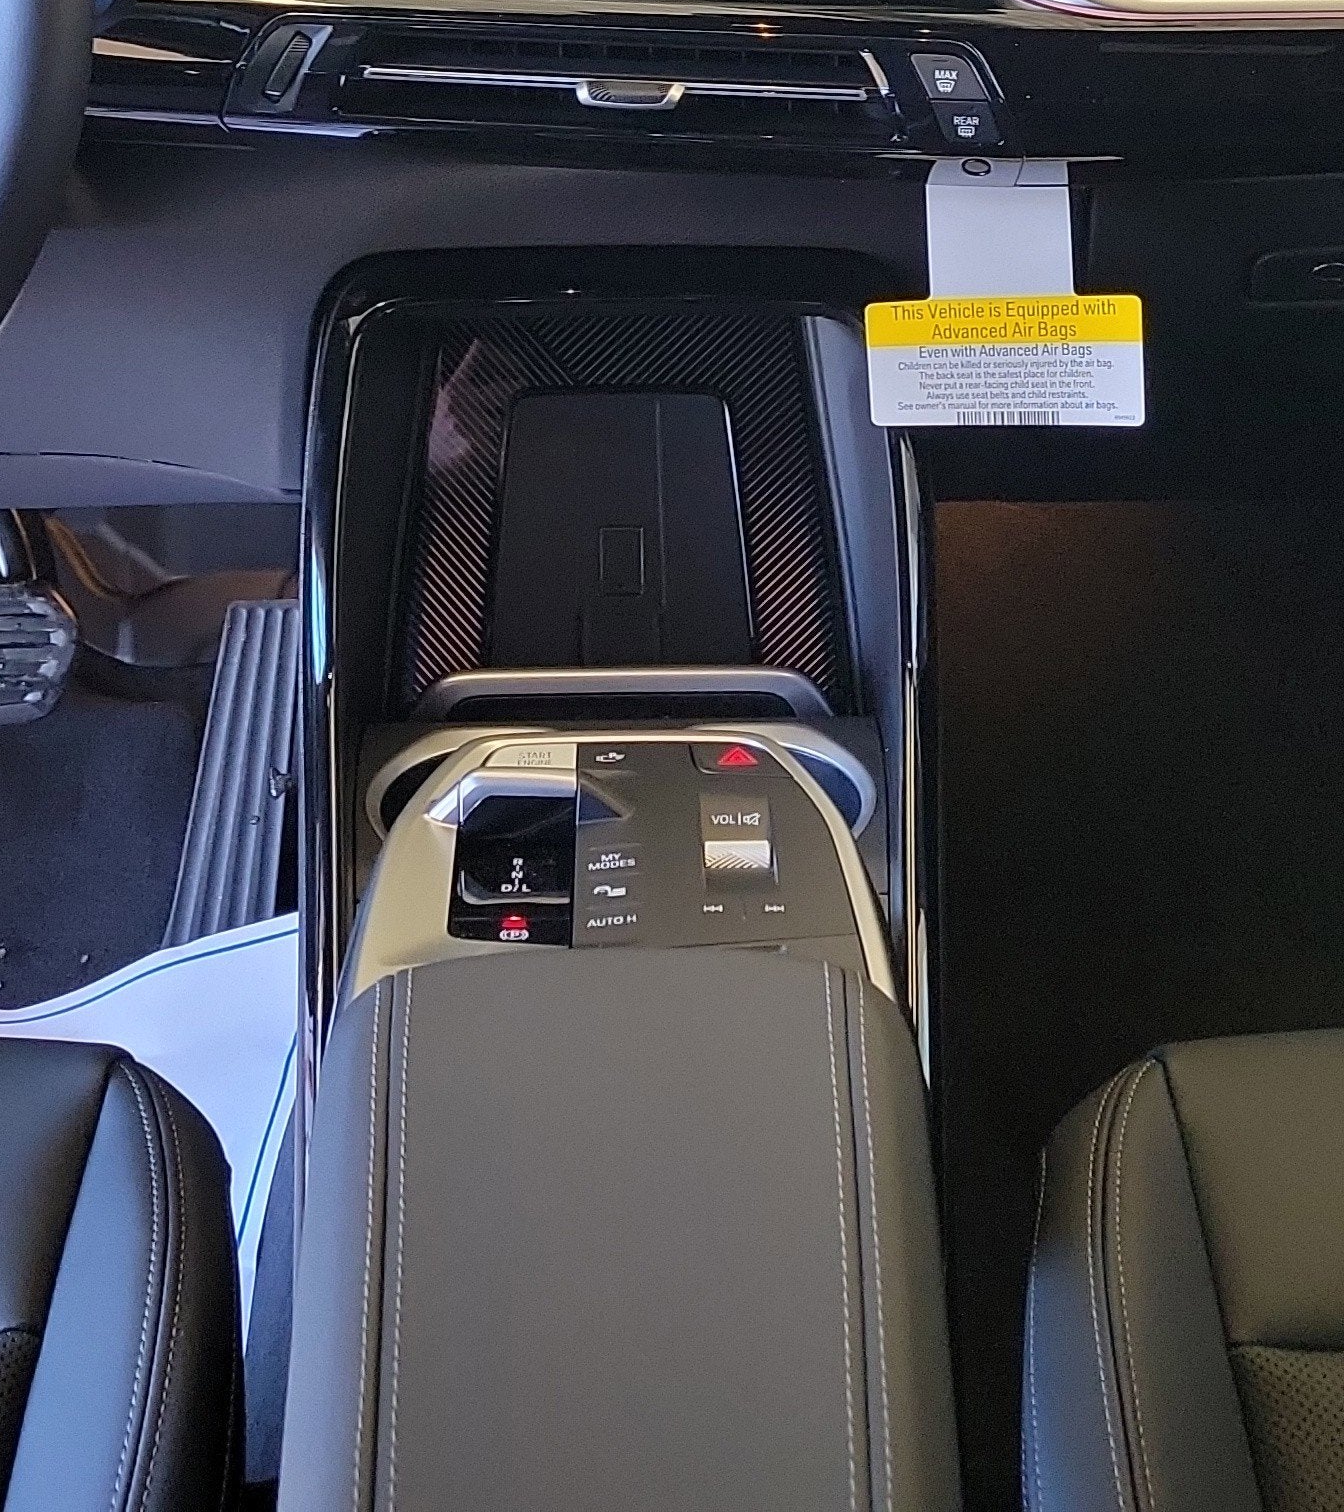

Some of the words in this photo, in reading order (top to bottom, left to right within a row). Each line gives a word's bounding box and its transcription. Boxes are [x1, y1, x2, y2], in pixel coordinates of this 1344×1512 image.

[934, 69, 958, 80] MAX
[953, 116, 979, 126] REAR
[890, 304, 924, 321] This
[928, 302, 985, 319] Vehicle
[988, 302, 1001, 318] is
[1006, 300, 1079, 320] Equipped
[1083, 299, 1116, 315] with
[932, 322, 1007, 340] Advanced
[1012, 322, 1034, 338] Air
[1038, 321, 1077, 340] Bags
[919, 346, 948, 359] Even
[950, 345, 976, 358] with
[979, 344, 1039, 357] Advanced
[1041, 343, 1058, 356] Air
[1061, 343, 1093, 359] Bags
[898, 361, 932, 370] Children
[933, 362, 947, 370] can
[948, 360, 959, 369] be
[960, 360, 982, 369] killed
[993, 360, 1028, 370] seriously
[1030, 359, 1057, 370] injured
[1059, 360, 1069, 370] by
[1070, 359, 1083, 368] the
[1084, 359, 1094, 368] air
[1097, 360, 1114, 369] bag.
[919, 371, 935, 380] The
[936, 371, 954, 379] back
[956, 371, 974, 379] seat
[975, 371, 982, 379] is
[983, 370, 997, 379] the
[998, 370, 1022, 379] safest
[1023, 370, 1045, 380] place
[1046, 370, 1057, 378] for
[1059, 369, 1094, 378] children.
[919, 381, 942, 390] Never
[944, 381, 957, 391] put
[965, 380, 1009, 390] rear-facing
[1010, 380, 1030, 388] child
[1031, 380, 1048, 388] seat
[1049, 380, 1056, 388] in
[1058, 380, 1071, 388] the
[1073, 379, 1095, 388] front.
[926, 391, 954, 401] Always
[971, 391, 988, 399] seat
[990, 391, 1009, 399] belts
[1011, 390, 1026, 399] and
[1028, 390, 1047, 399] child
[1048, 390, 1089, 399] restraints.
[897, 401, 913, 410] See
[915, 401, 946, 410] owner's
[947, 401, 976, 409] manual
[978, 400, 989, 409] for
[991, 401, 1011, 409] more
[1013, 400, 1058, 409] information
[1060, 400, 1083, 409] about
[1084, 400, 1094, 409] air
[1097, 400, 1118, 411] bags.
[518, 751, 552, 759] START
[711, 814, 736, 825] VOL
[513, 858, 524, 866] R
[600, 852, 622, 862] MY
[587, 858, 636, 871] MODES
[511, 870, 524, 879] N
[586, 916, 624, 928] AUTO
[626, 914, 637, 923] H
